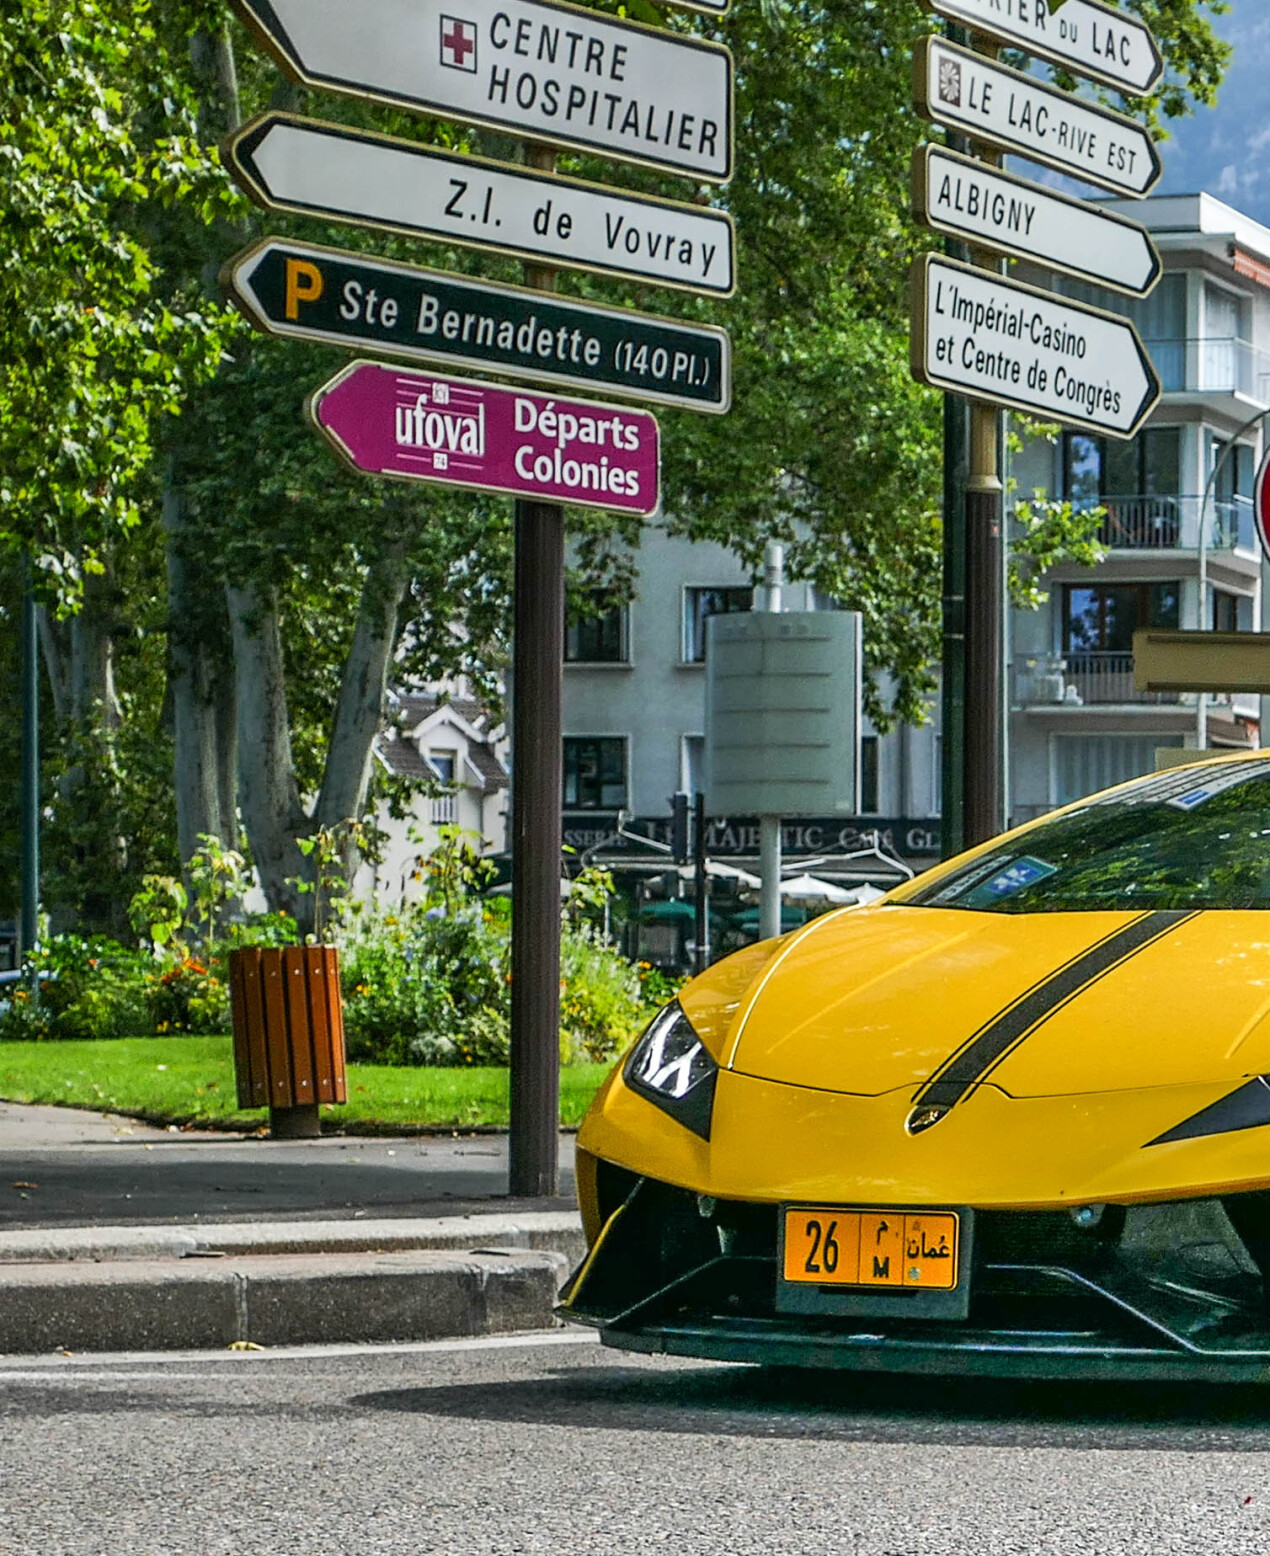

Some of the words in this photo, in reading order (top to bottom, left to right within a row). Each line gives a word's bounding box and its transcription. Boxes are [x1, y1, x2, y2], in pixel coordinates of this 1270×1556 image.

[489, 12, 629, 81] CENTRE
[1059, 18, 1079, 44] DU
[1091, 21, 1131, 67] LAC
[488, 67, 719, 158] HOSPITALIER
[968, 75, 993, 115] LE
[1107, 141, 1137, 176] EST
[444, 178, 502, 228] Z.I.
[533, 200, 573, 239] de
[604, 212, 717, 277] Vovray
[938, 174, 1036, 236] ALBIGNY
[340, 280, 399, 328] Ste
[417, 294, 602, 367] Bernadette
[935, 335, 955, 364] et
[961, 337, 1021, 386] Centre
[1027, 358, 1048, 393] de
[1053, 370, 1121, 416] Congrès
[396, 393, 485, 456] ufoval
[514, 397, 640, 453] Départs
[514, 446, 640, 497] Colonies
[703, 824, 824, 852] MAJETIC
[906, 827, 941, 850] GL
[804, 1219, 839, 1273] 26
[872, 1256, 890, 1279] M
